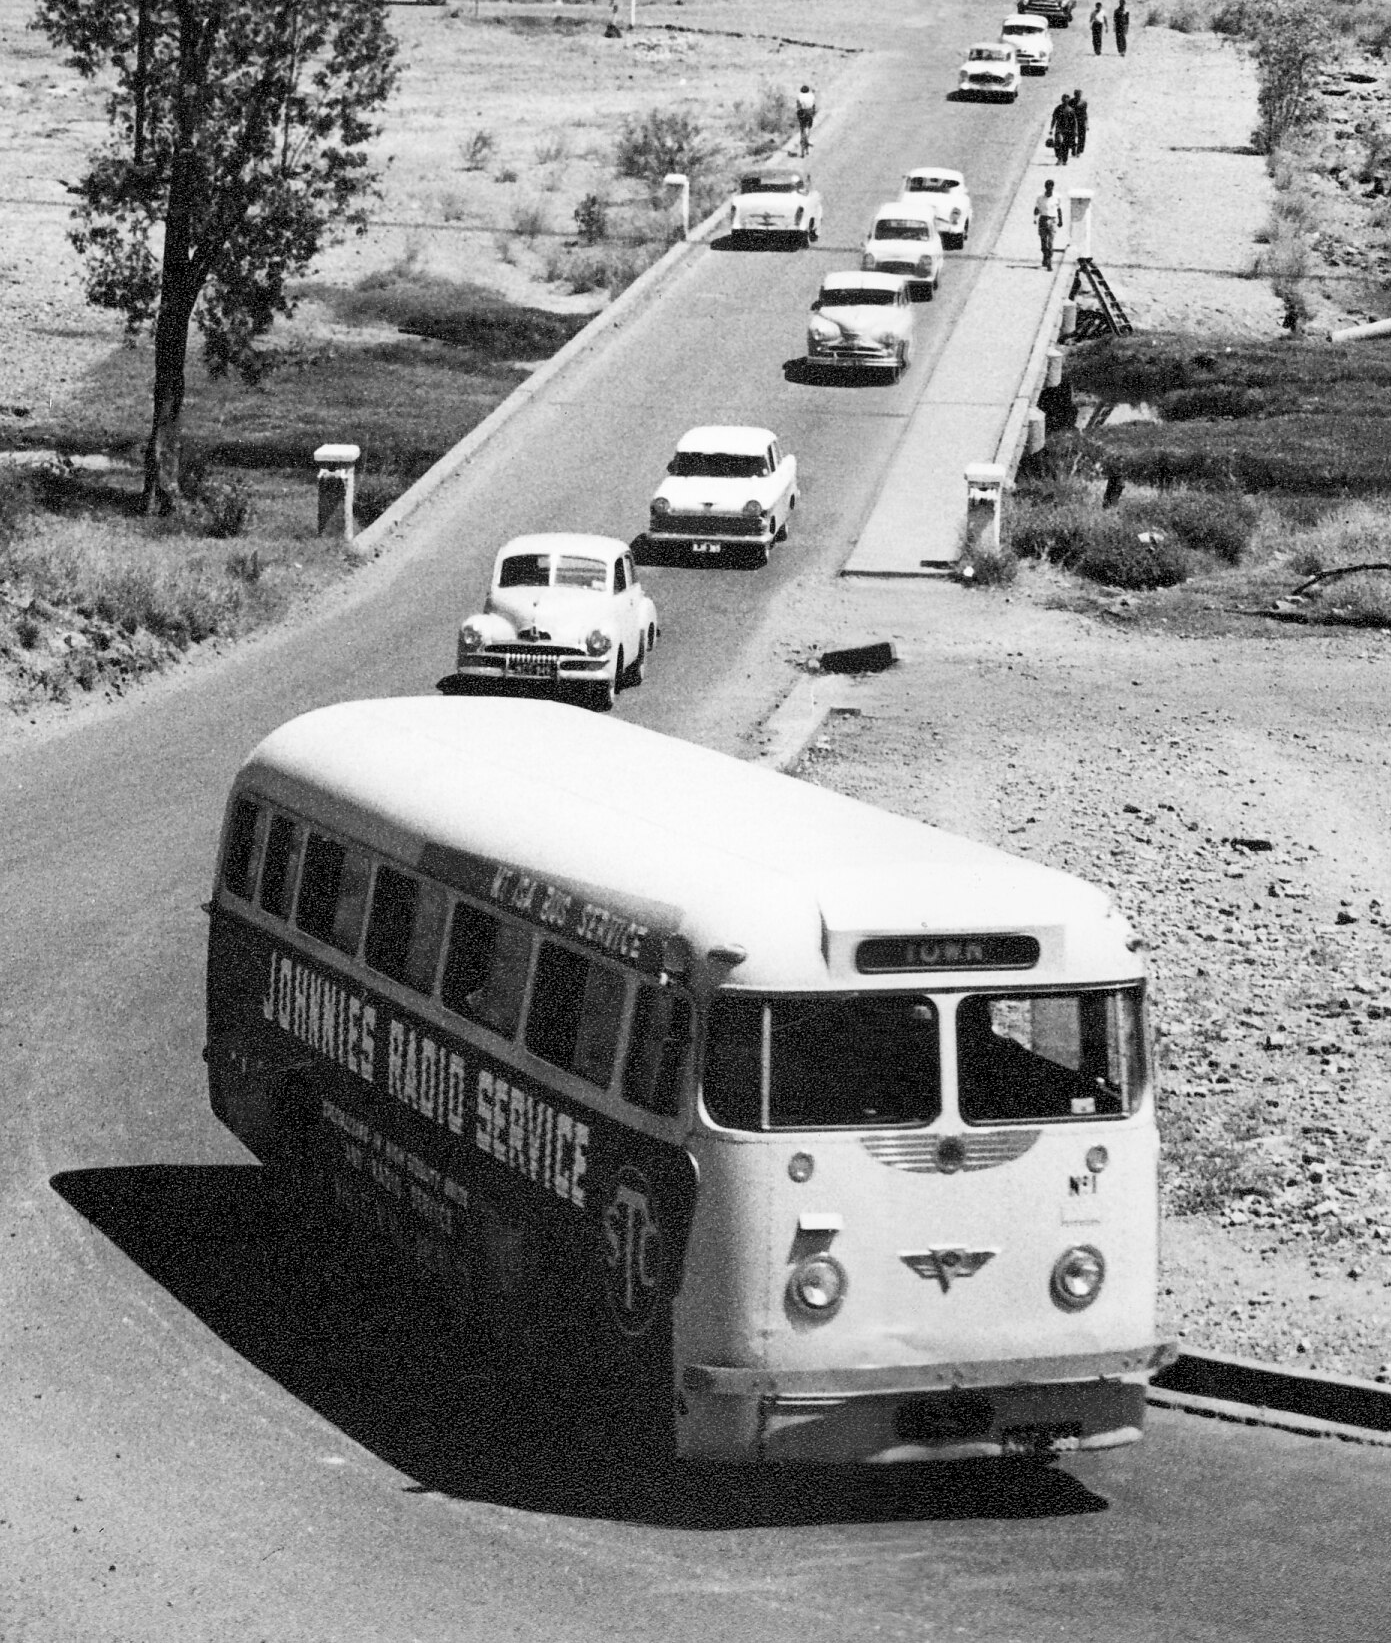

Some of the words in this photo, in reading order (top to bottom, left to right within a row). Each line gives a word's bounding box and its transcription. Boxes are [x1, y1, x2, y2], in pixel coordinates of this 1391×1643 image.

[540, 885, 572, 927] BUS
[577, 903, 648, 959] SERVICE
[905, 942, 983, 963] TOWN
[387, 1019, 465, 1135] RADIO
[476, 1069, 590, 1209] SERVICE
